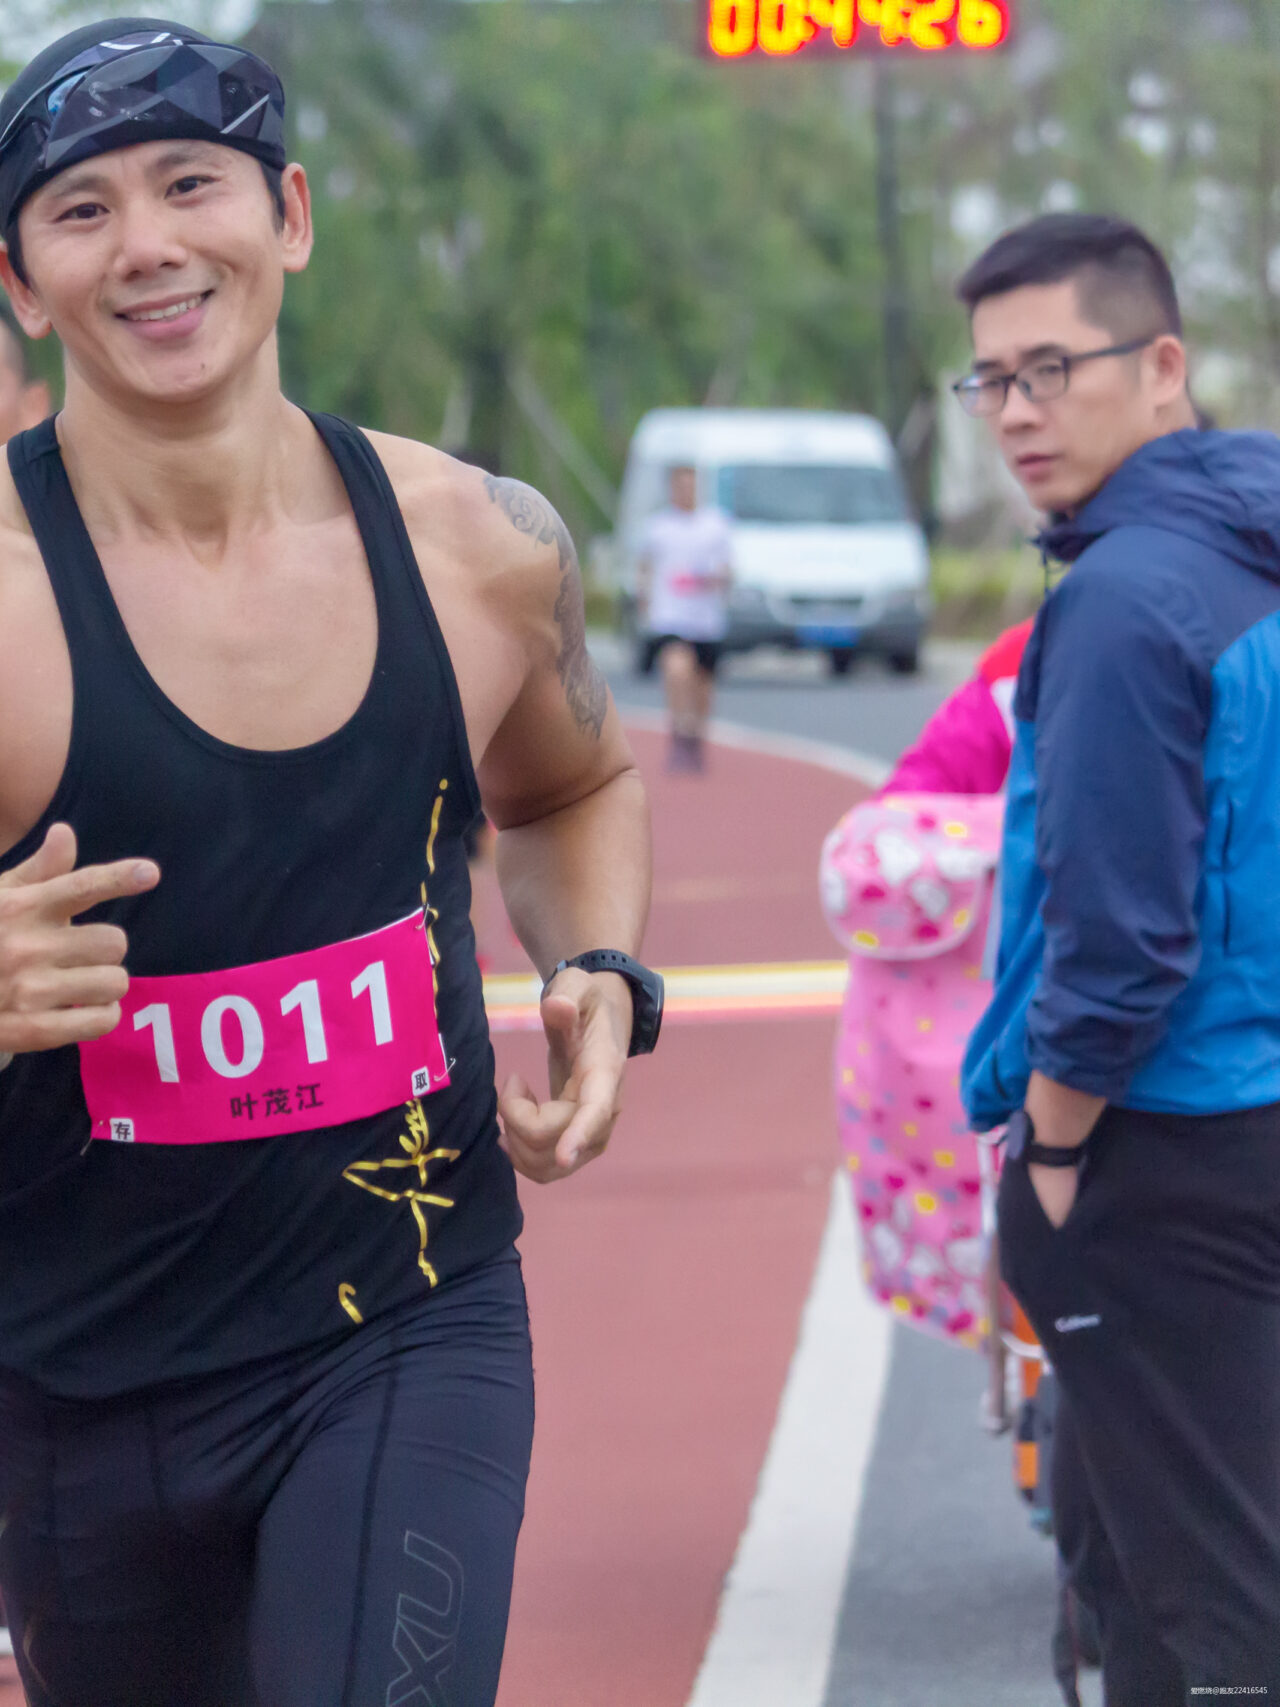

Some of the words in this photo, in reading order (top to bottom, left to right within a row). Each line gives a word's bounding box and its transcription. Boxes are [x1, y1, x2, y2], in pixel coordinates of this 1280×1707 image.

[132, 960, 394, 1084] 1011
[414, 1071, 428, 1090] 取
[230, 1083, 324, 1120] 叶茂江
[113, 1121, 131, 1140] 存
